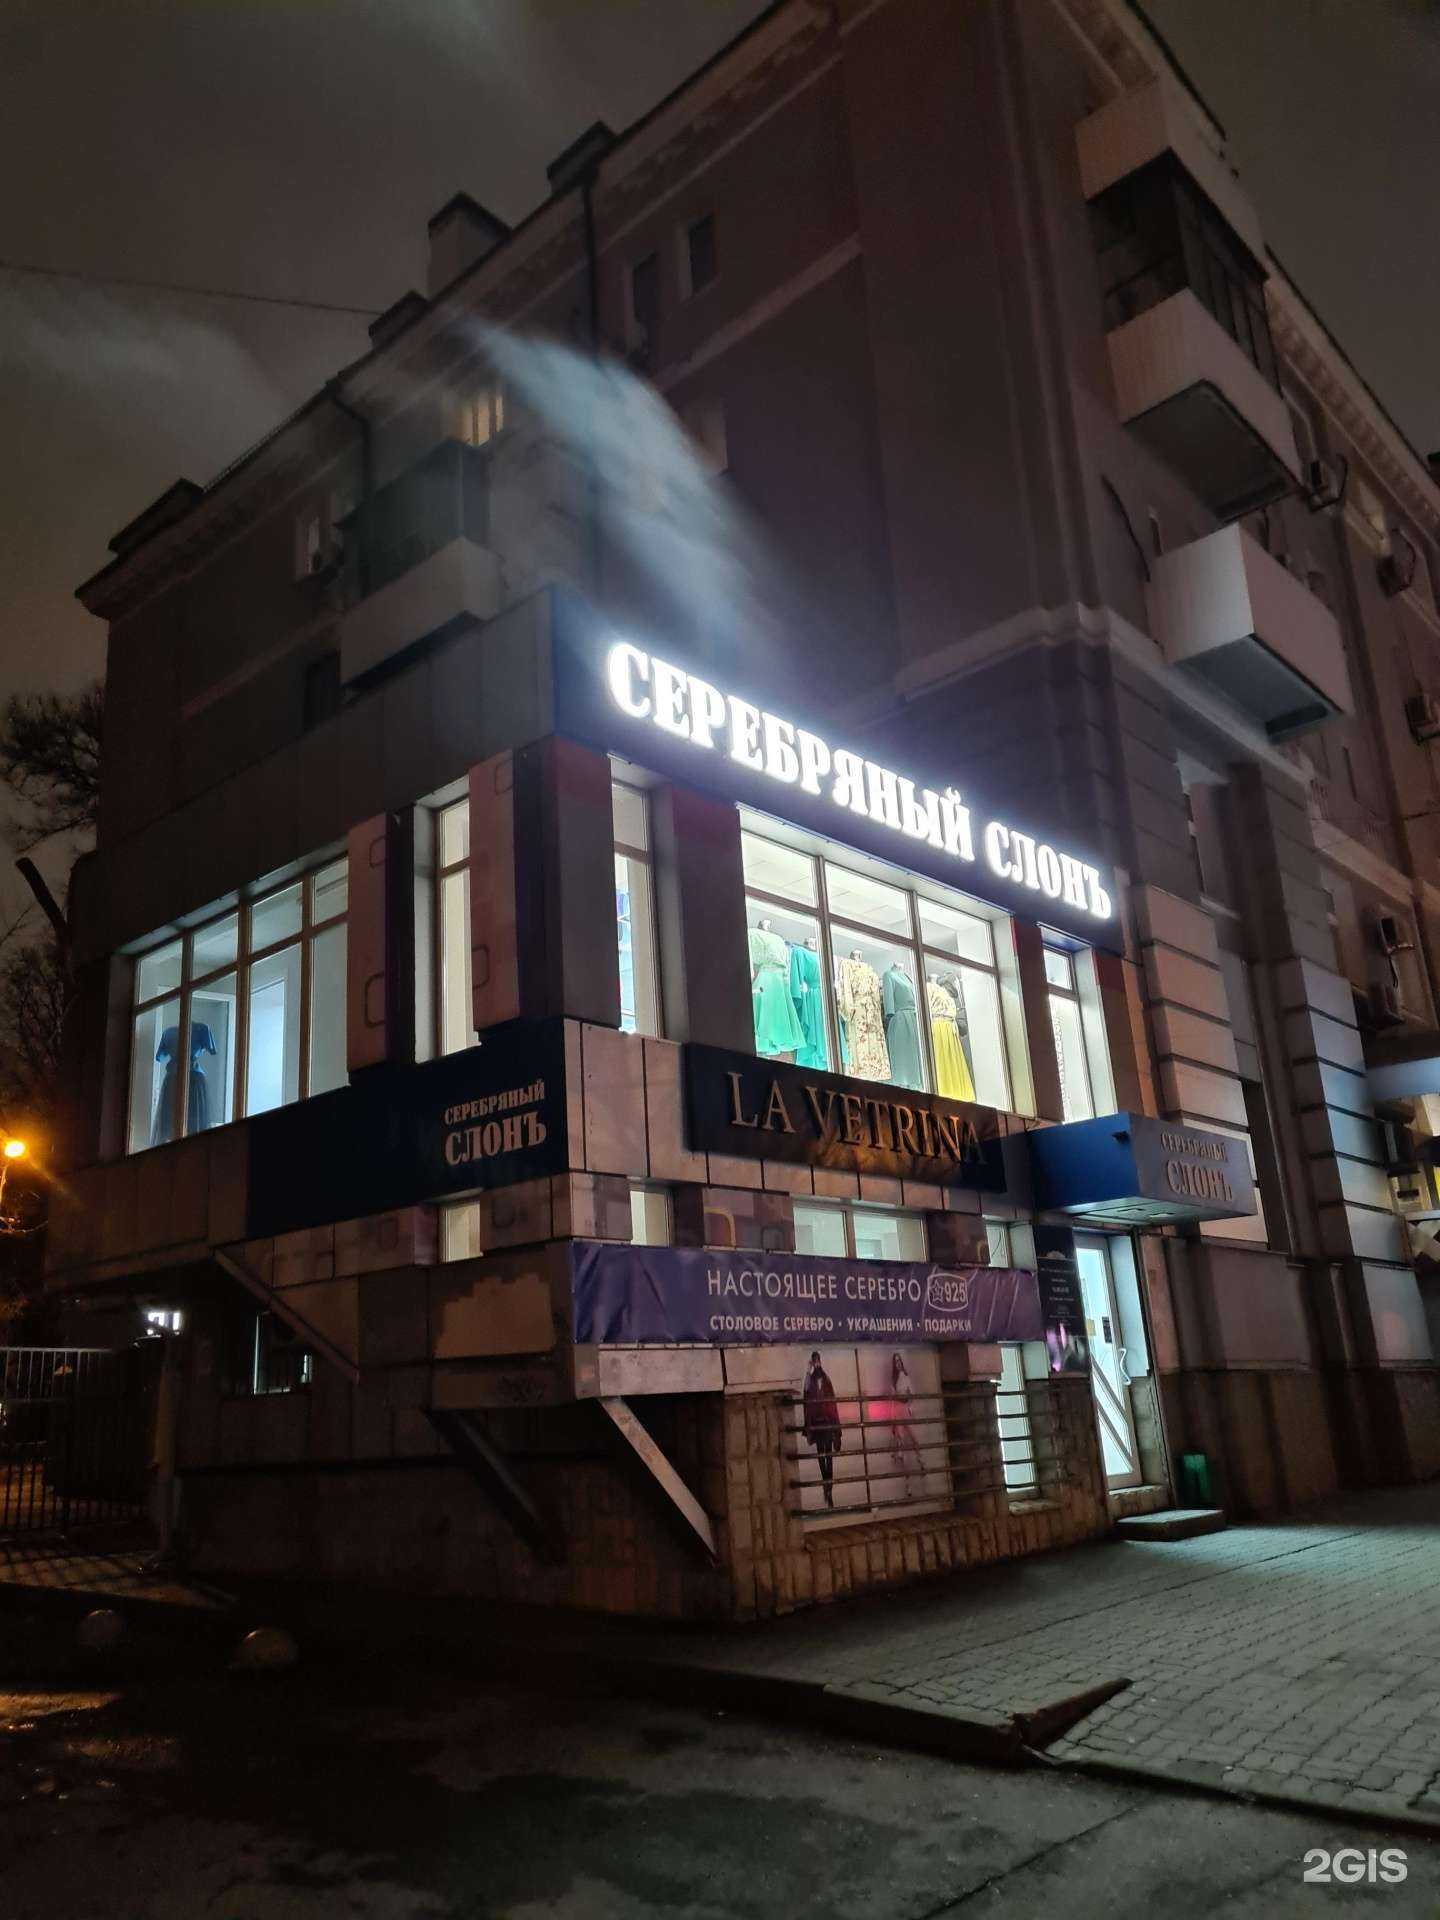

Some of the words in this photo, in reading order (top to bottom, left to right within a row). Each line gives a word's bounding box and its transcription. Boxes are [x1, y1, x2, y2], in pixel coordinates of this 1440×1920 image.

[607, 643, 974, 862] СЕРЕБРЯНЫЙ
[985, 821, 1112, 919] СЛОНЪ
[445, 1078, 545, 1125] СЕРЕБРЯНЫЙ
[727, 1071, 796, 1134] LA
[805, 1085, 988, 1165] VETRINA
[445, 1111, 547, 1166] СЛОНЪ
[707, 1270, 837, 1303] НАСТОЯЩЕЕ
[845, 1276, 921, 1301] СЕРЕБРО
[944, 1280, 966, 1302] 925
[710, 1315, 779, 1332] СТОЛОВОЕ
[782, 1317, 834, 1332] СЕРЕБРО
[847, 1318, 913, 1332] УКРАШЕНИЯ
[924, 1319, 972, 1333] ПОДАРКИ
